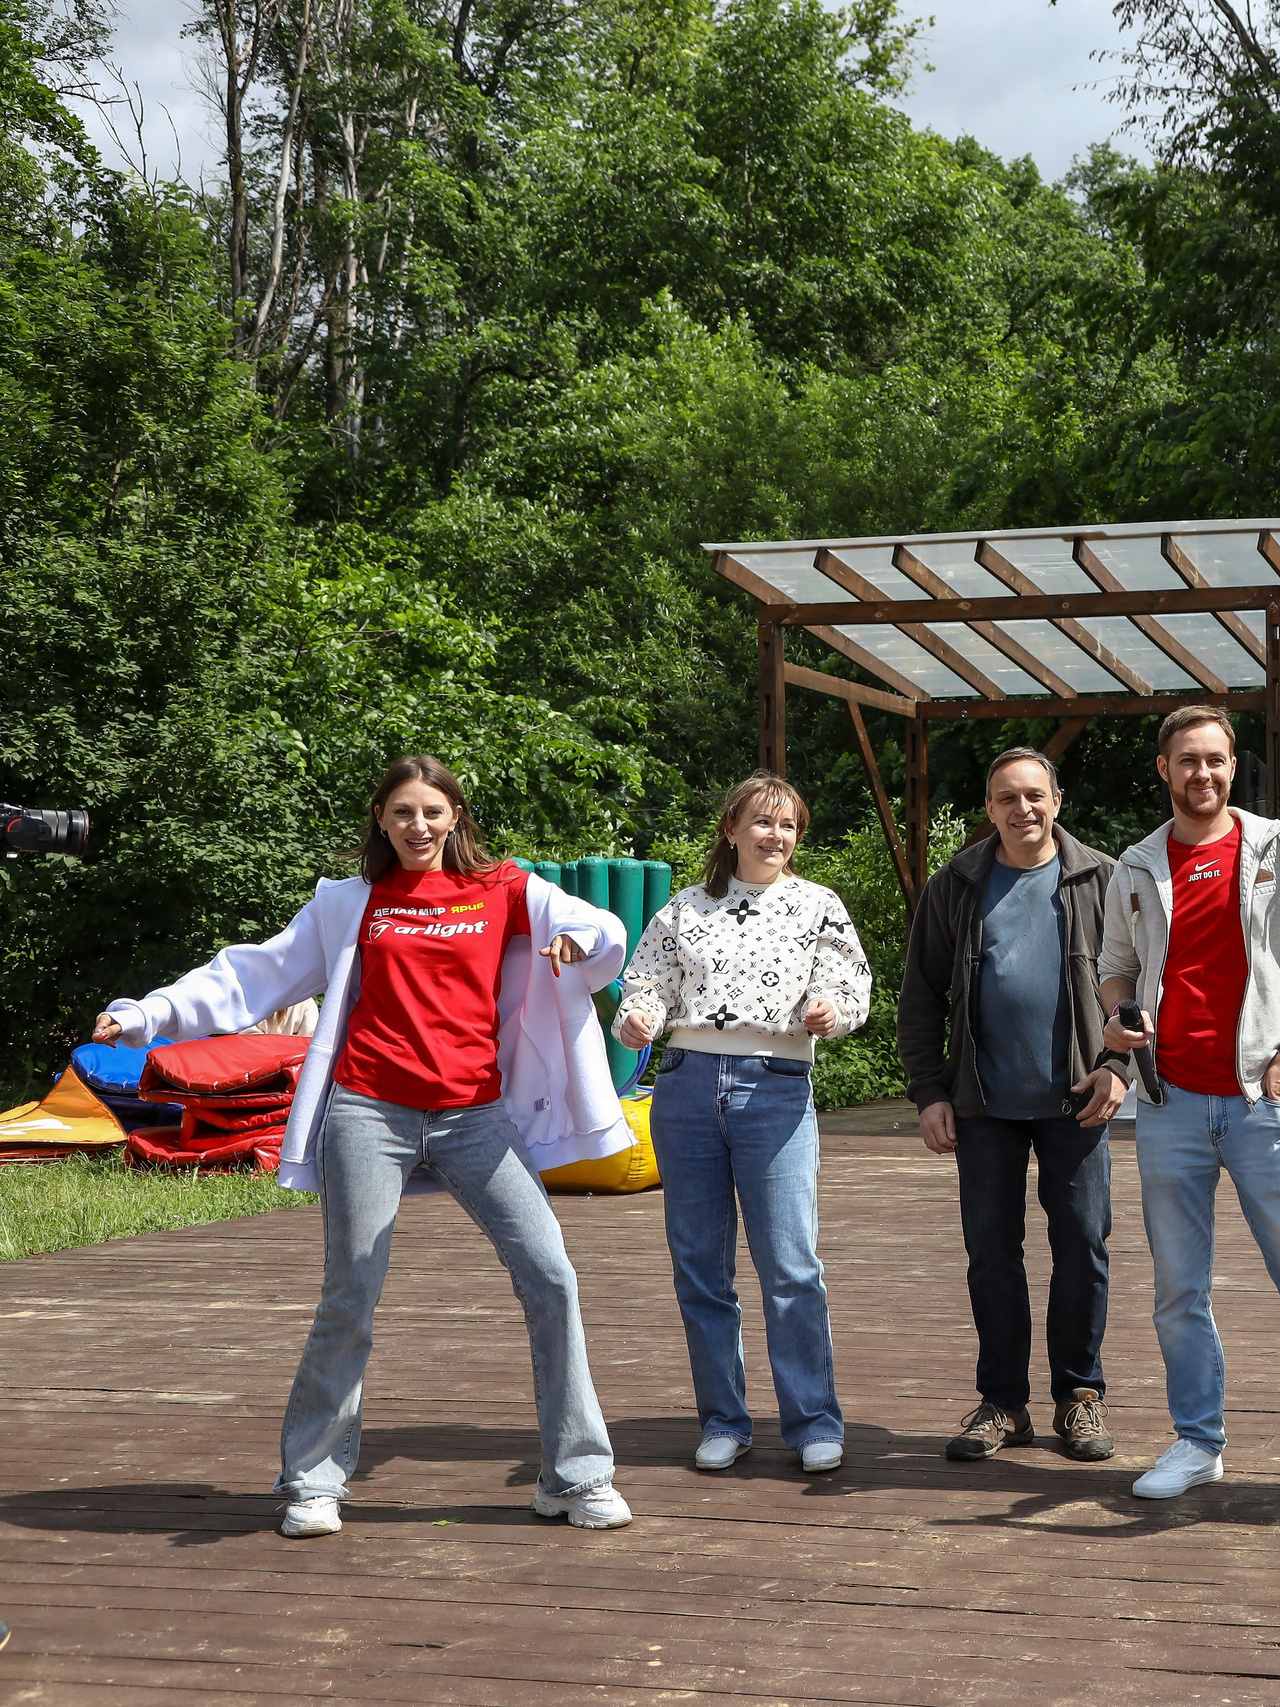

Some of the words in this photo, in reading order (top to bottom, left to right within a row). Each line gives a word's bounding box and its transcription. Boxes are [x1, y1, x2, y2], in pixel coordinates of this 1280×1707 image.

[1188, 873, 1202, 882] JUST
[1203, 871, 1213, 879] DO
[372, 907, 417, 917] ДЕЛАЙ
[418, 907, 446, 916] МИР
[450, 901, 485, 914] ЯРЧЕ
[394, 921, 486, 938] arlight
